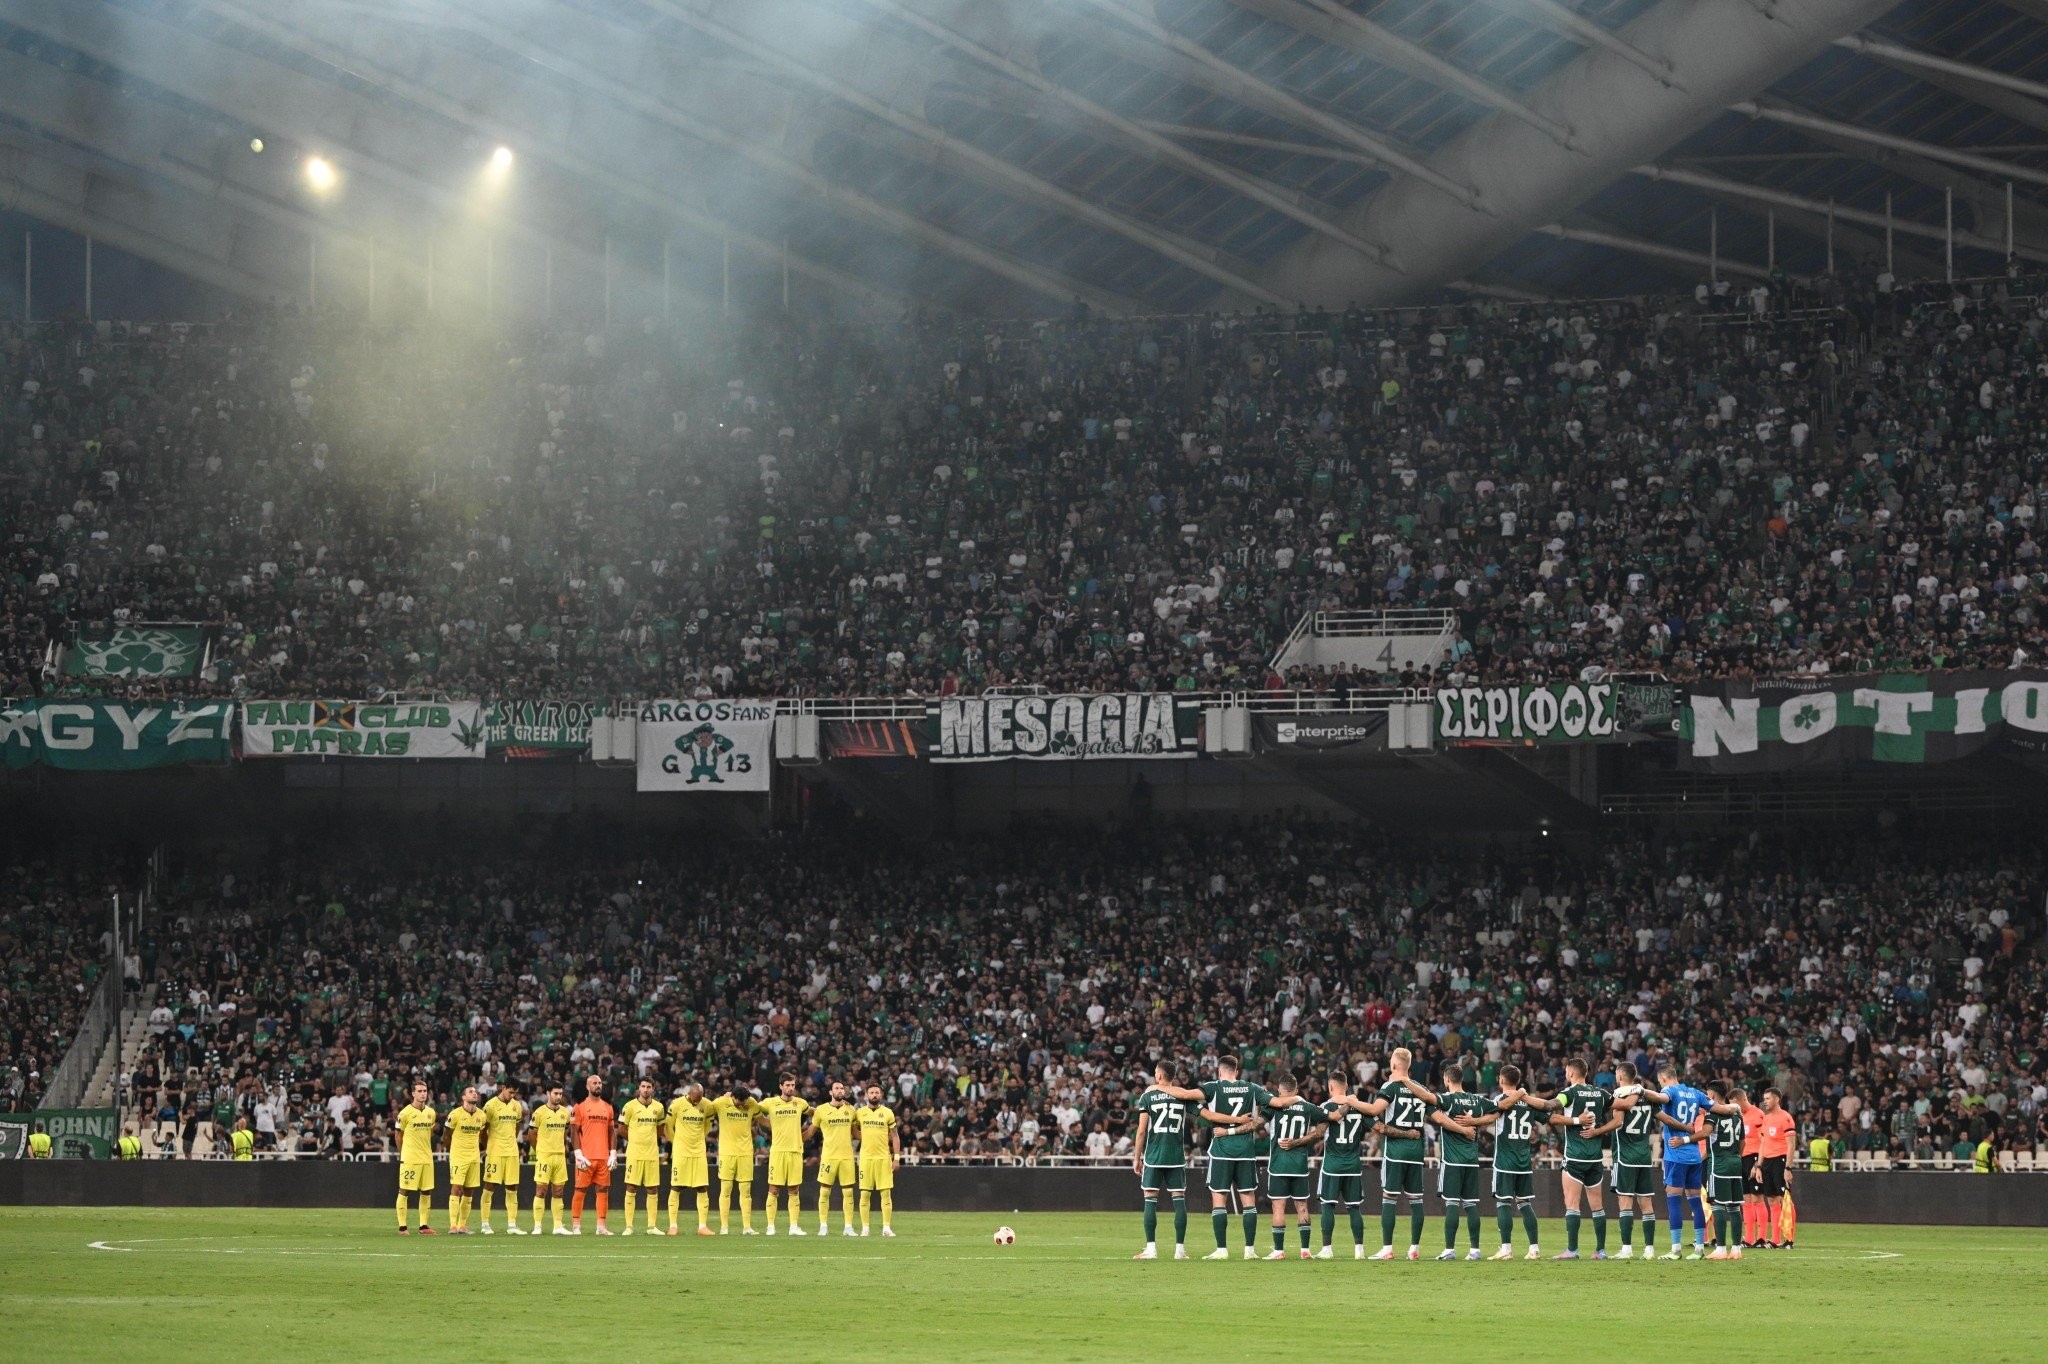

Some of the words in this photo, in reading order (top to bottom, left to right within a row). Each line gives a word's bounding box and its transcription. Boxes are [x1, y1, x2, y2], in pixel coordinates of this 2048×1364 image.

[1375, 639, 1395, 670] 4
[246, 702, 311, 726] FAN
[359, 706, 452, 729] CLUB
[499, 700, 595, 729] SKYROS
[640, 703, 730, 722] ARGOS
[732, 707, 772, 720] FANS
[940, 694, 1177, 755] MESOGIA
[1437, 684, 1614, 738] ΣΕΡΙΦΟΣ
[271, 729, 411, 755] PATRAS
[486, 725, 507, 742] THE
[514, 725, 559, 743] GREEN
[1075, 736, 1123, 760] gate
[1131, 732, 1158, 754] 13
[1279, 724, 1366, 740] enterprise
[661, 754, 681, 774] G
[725, 753, 752, 773] 13
[1150, 1103, 1184, 1133] 25
[1228, 1097, 1243, 1126] 7
[1395, 1097, 1426, 1128] 23
[1507, 1110, 1533, 1140] 16
[1625, 1105, 1652, 1135] 27
[1677, 1101, 1697, 1125] 91
[1277, 1114, 1306, 1145] 10
[1335, 1114, 1362, 1143] 17
[404, 1170, 415, 1180] 22
[486, 1163, 497, 1173] 23
